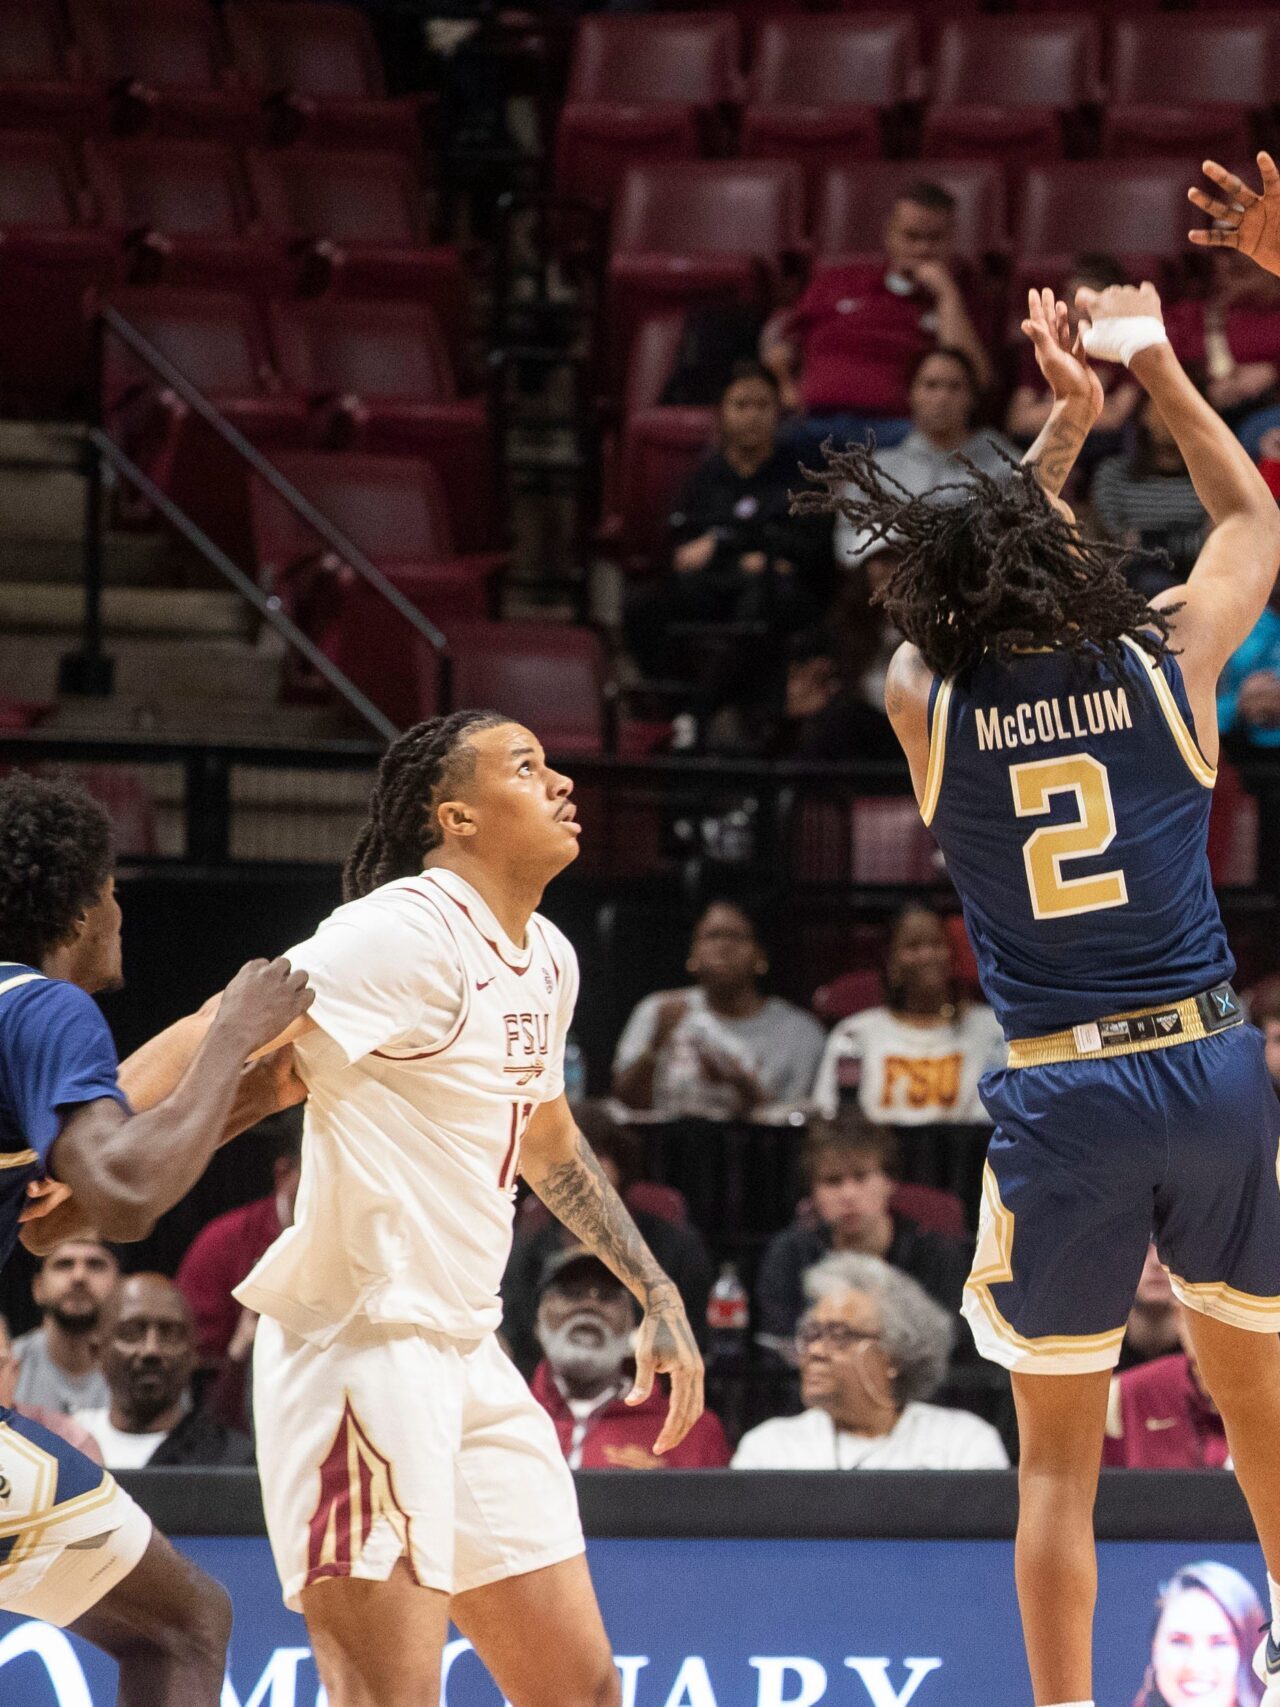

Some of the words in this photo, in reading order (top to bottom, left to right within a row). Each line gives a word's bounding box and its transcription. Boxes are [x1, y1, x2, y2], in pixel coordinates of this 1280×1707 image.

[974, 686, 1133, 751] McCOLLUM
[1008, 752, 1129, 920] 2
[503, 1012, 549, 1057] FSU
[881, 1052, 963, 1110] FSU
